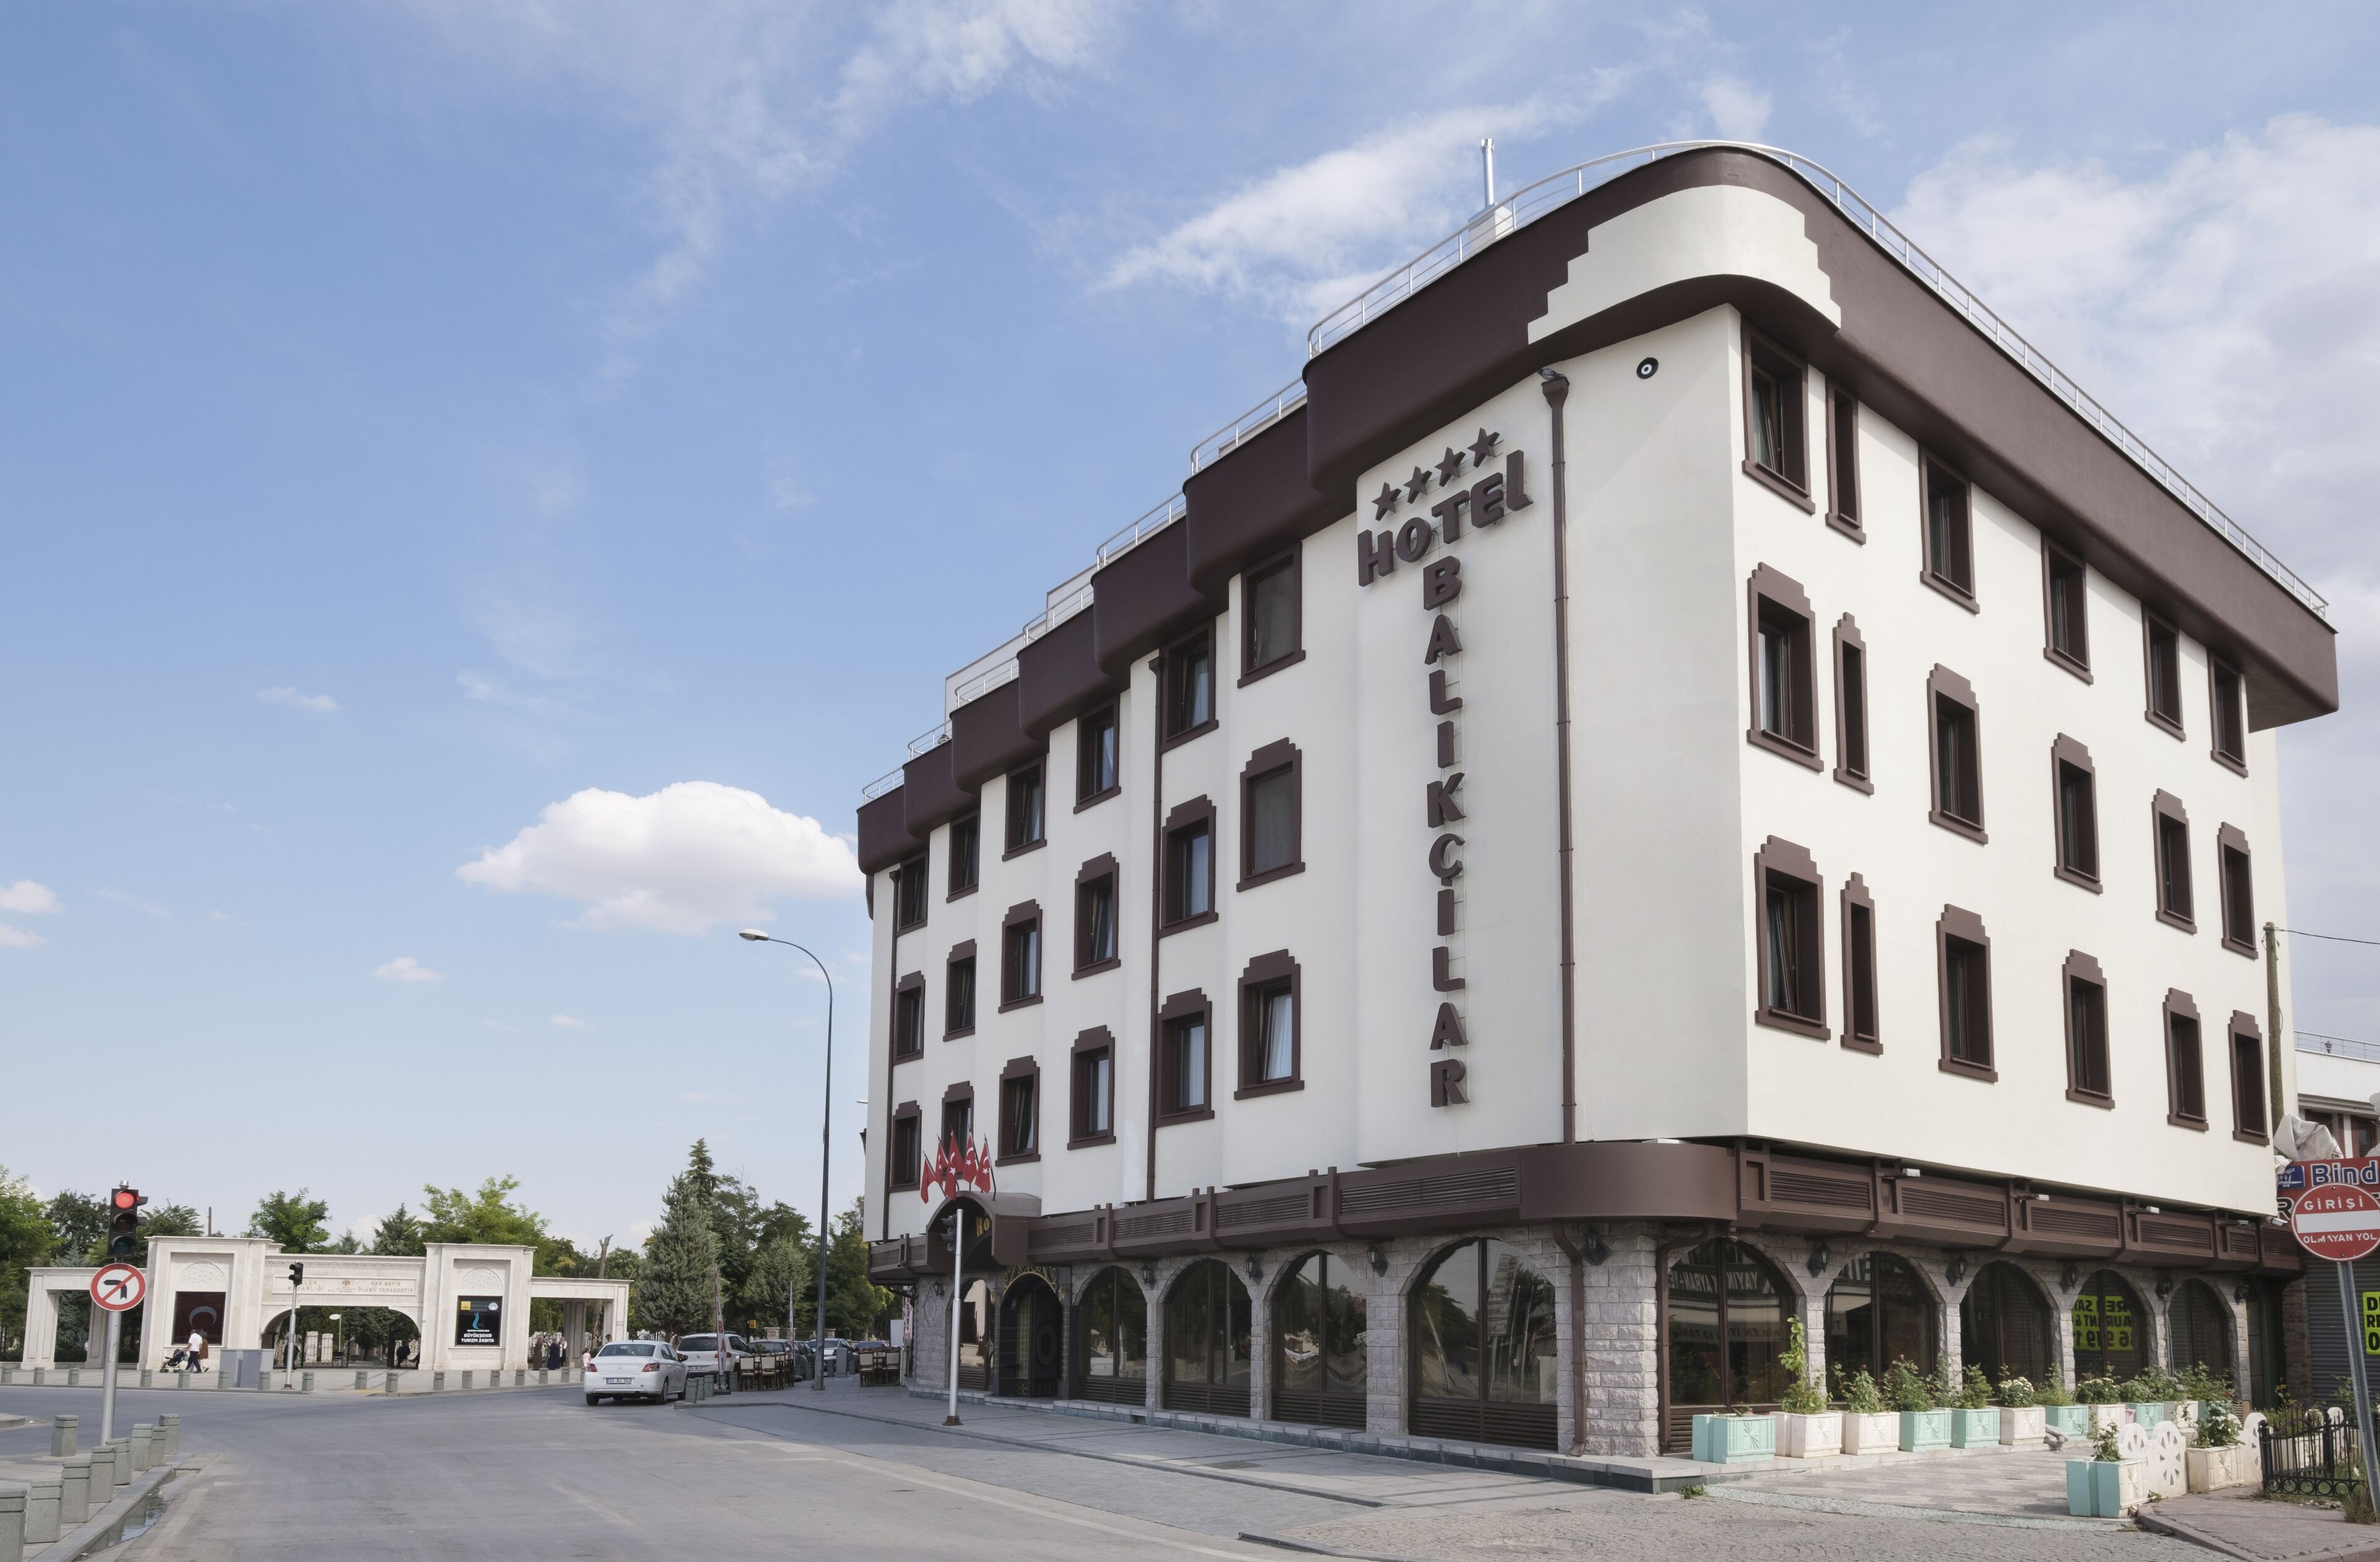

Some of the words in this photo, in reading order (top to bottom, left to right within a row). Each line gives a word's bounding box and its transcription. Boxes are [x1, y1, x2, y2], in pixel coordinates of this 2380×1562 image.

[1357, 449, 1534, 587] HOTEL
[1423, 555, 1470, 1108] BALIKÇILAR
[2304, 1196, 2364, 1211] GİRİŞİ
[2356, 1232, 2378, 1241] YOL
